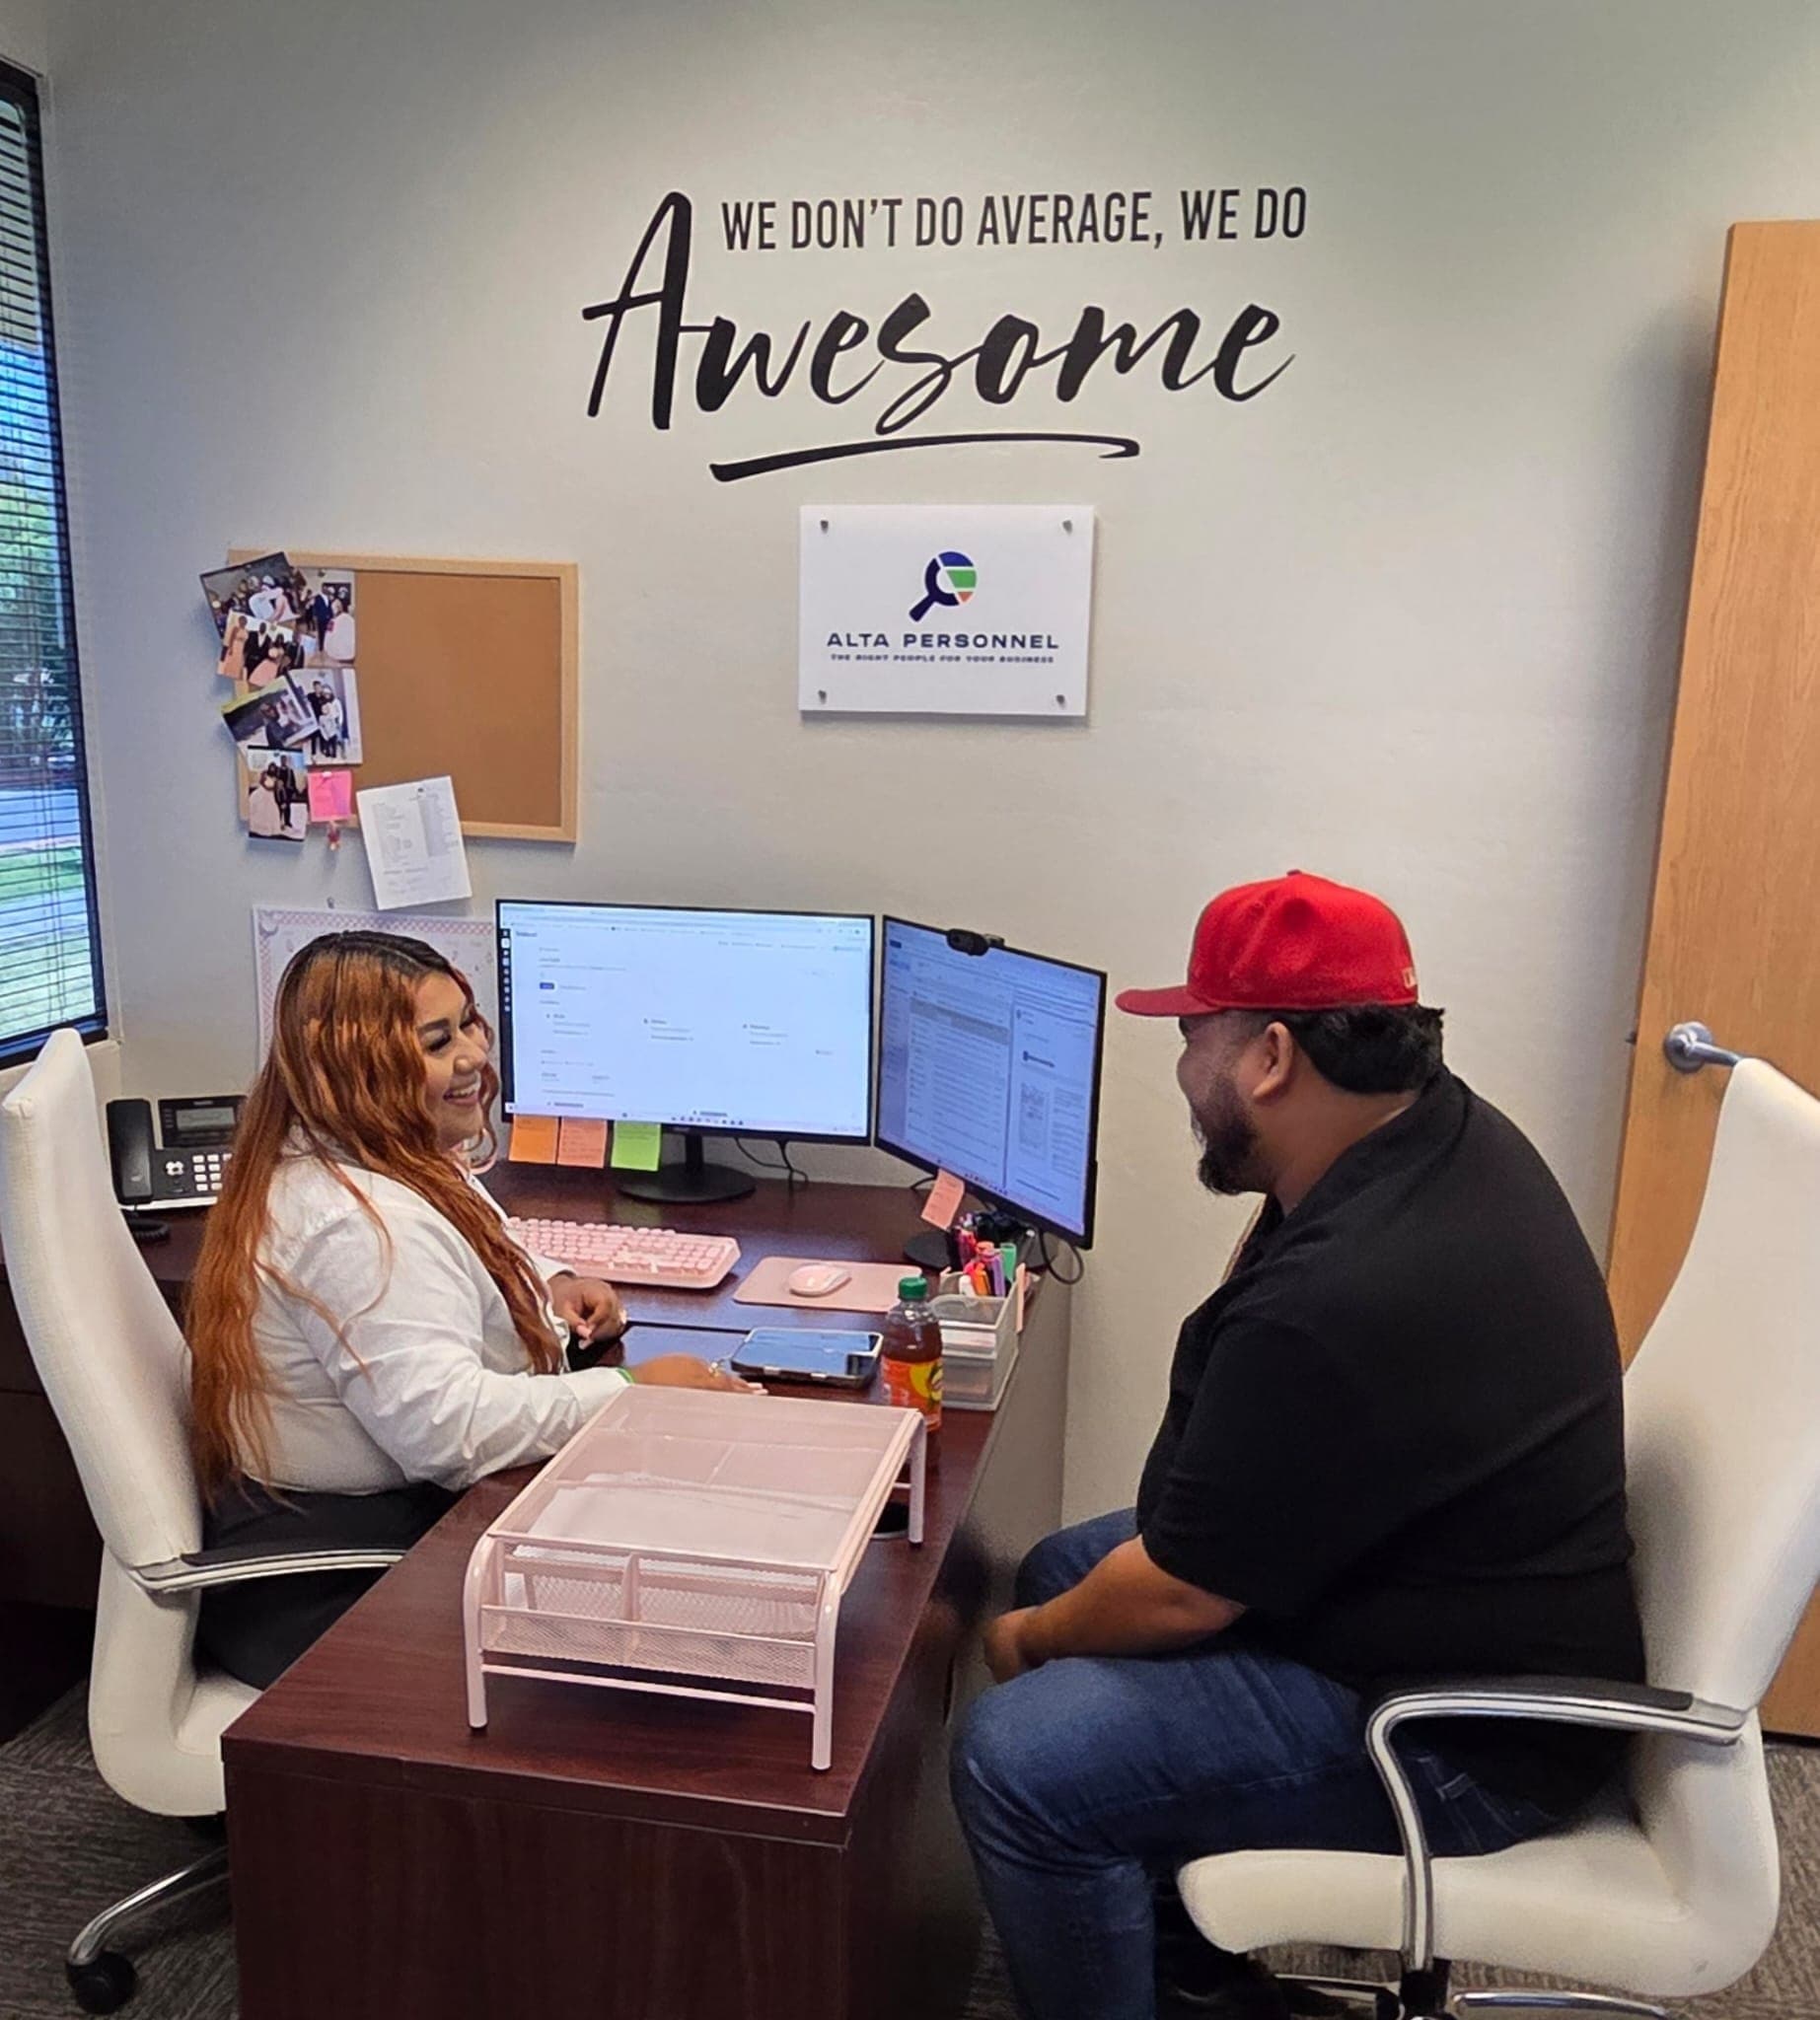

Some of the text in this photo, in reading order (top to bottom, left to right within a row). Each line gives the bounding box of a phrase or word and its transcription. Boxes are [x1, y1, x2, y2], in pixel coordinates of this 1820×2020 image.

[721, 186, 1308, 251] WE DON’T DO AVERAGE, WE DO
[581, 191, 1294, 436] Awesome
[826, 632, 1060, 650] ALTA PERSONNEL
[830, 653, 851, 662] THE
[854, 653, 890, 662] RIGHT
[892, 654, 936, 663] PEOPLE
[939, 654, 962, 663] FOR
[998, 655, 1055, 664] BUSINESS
